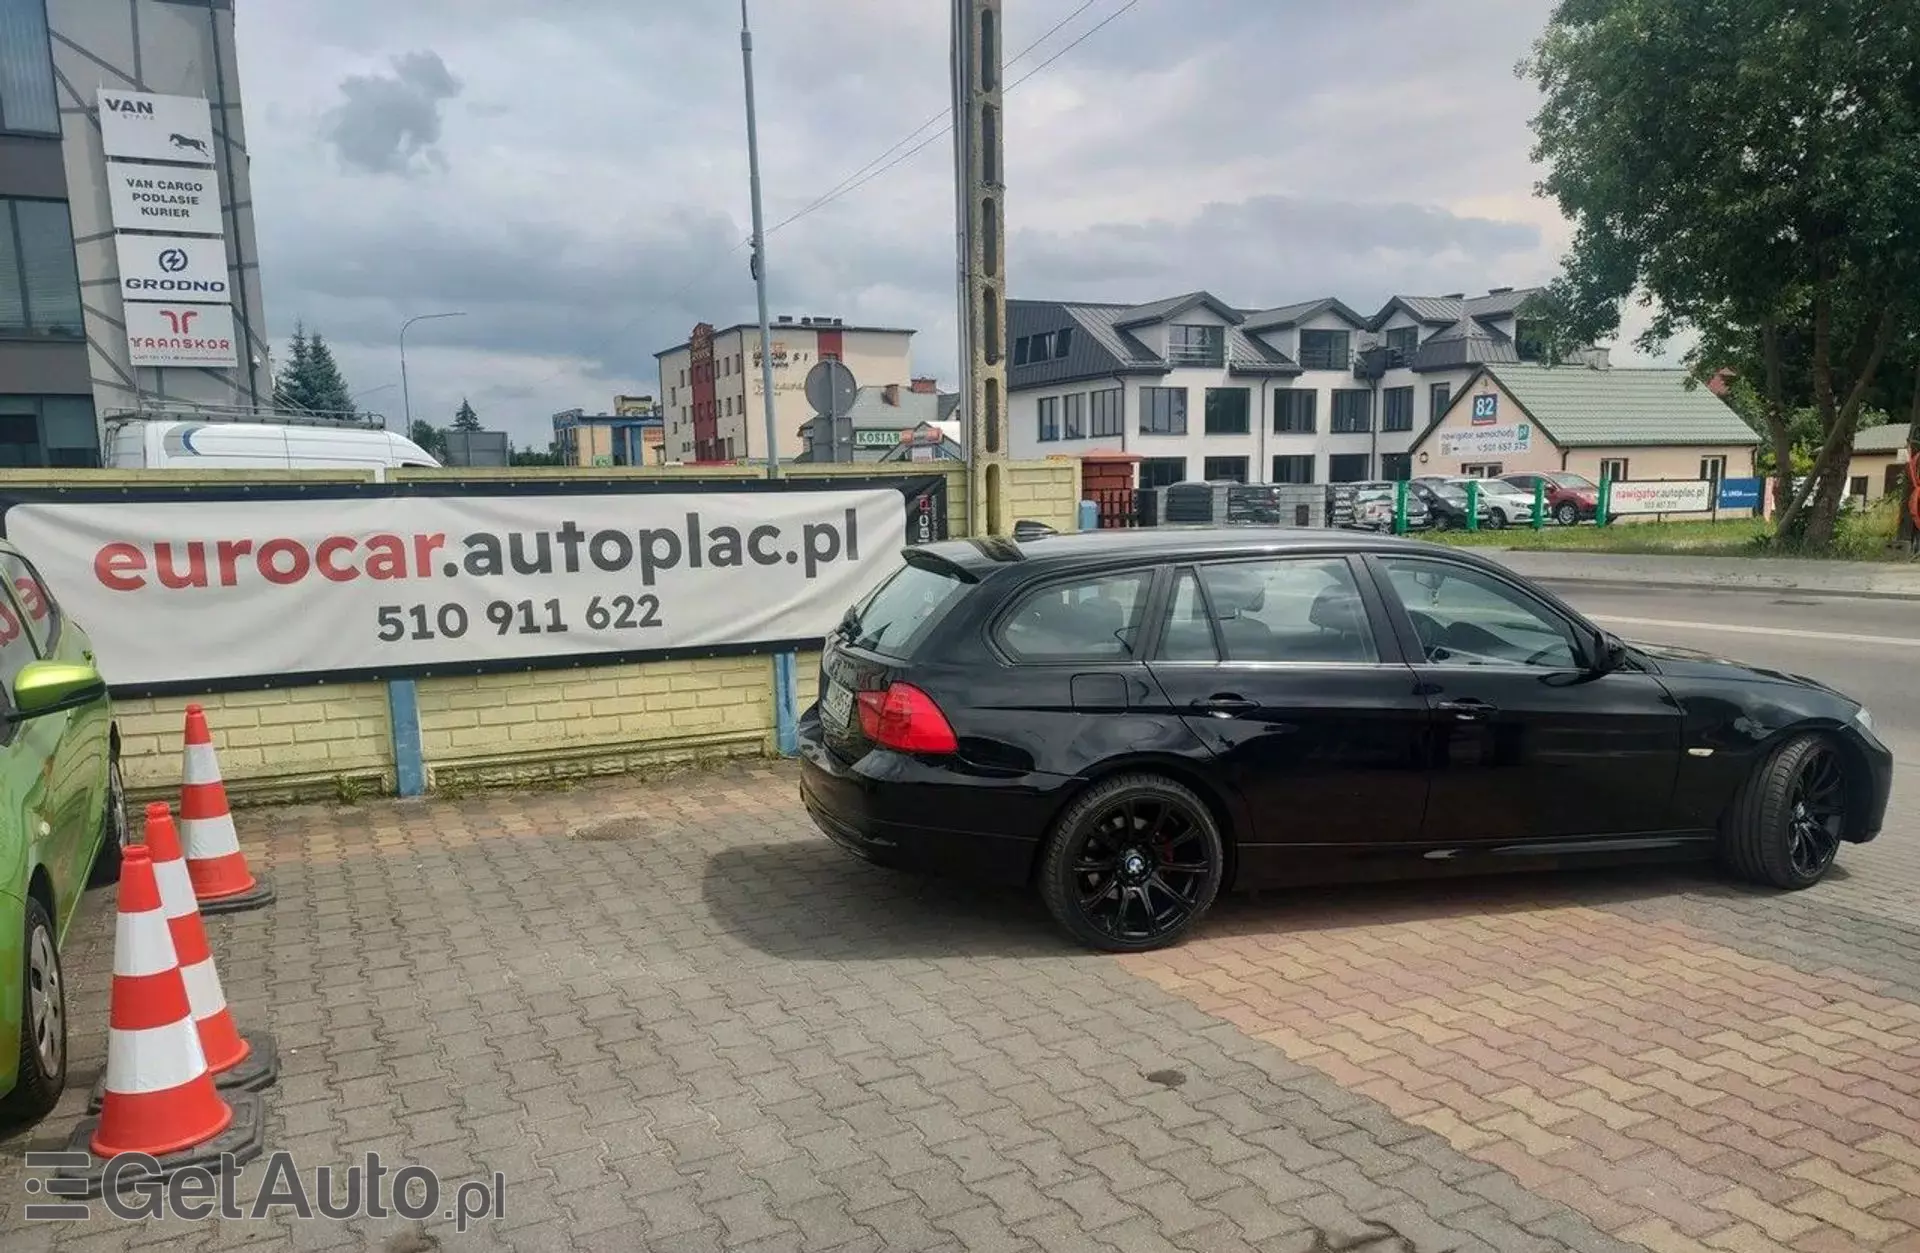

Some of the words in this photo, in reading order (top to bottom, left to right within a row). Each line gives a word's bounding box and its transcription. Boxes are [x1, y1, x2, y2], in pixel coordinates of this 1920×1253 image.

[105, 98, 154, 114] VAN
[126, 178, 153, 190] VAN
[157, 180, 203, 192] CARGO
[132, 192, 200, 206] PODLASIE
[141, 206, 190, 218] KURIER
[125, 278, 225, 293] GRODNO
[130, 336, 229, 350] TRANSKOR
[1475, 397, 1494, 416] 82
[94, 508, 859, 592] eurocar.autoplac.pl
[377, 603, 469, 642] 510
[486, 599, 568, 636] 911
[585, 595, 663, 631] 622
